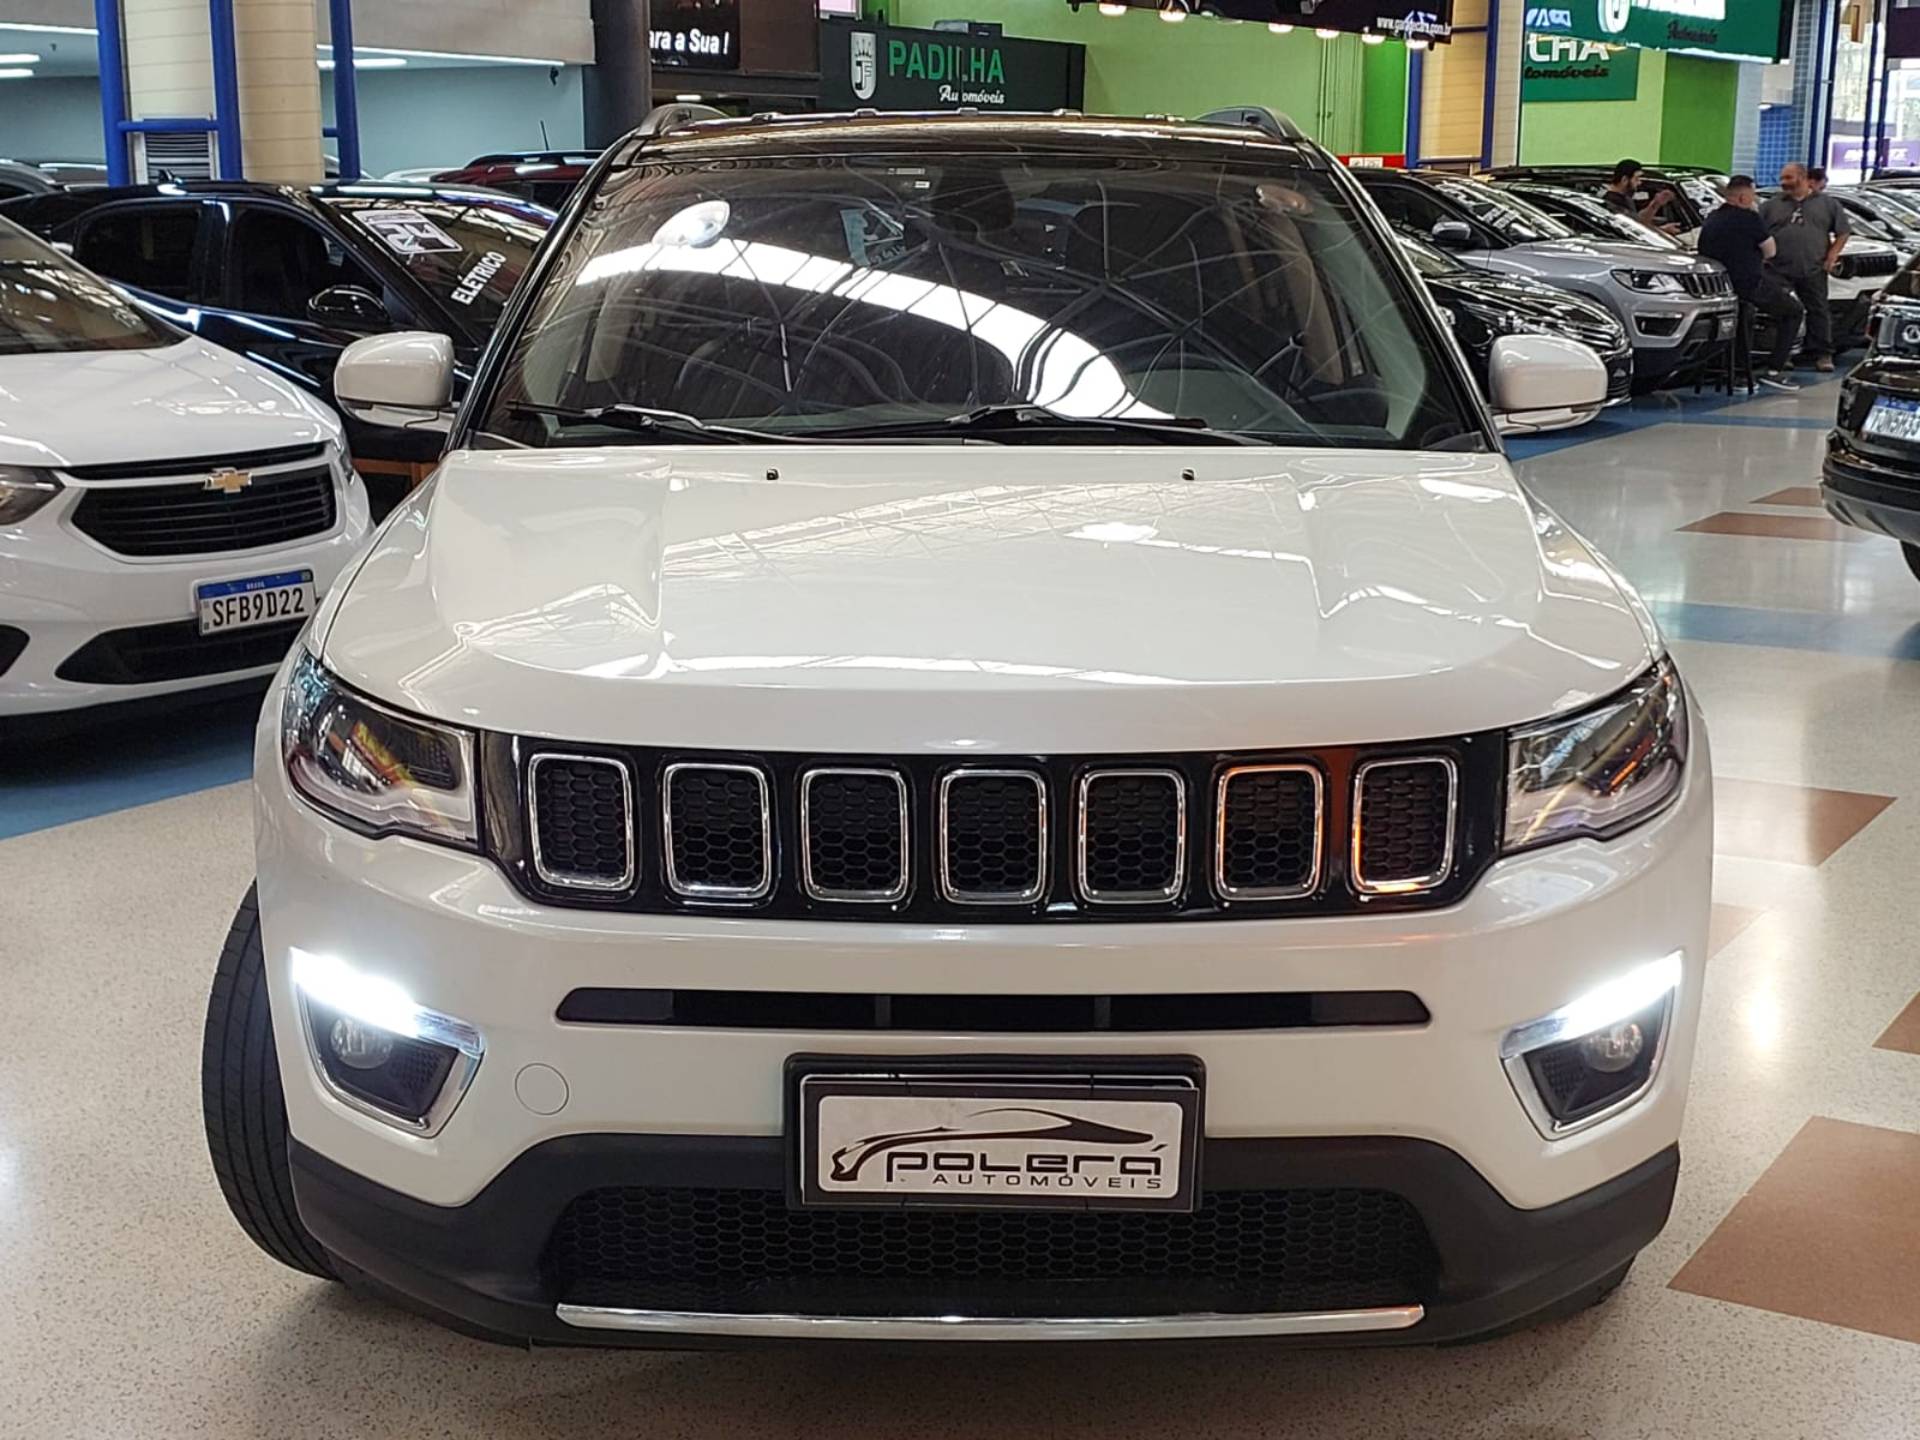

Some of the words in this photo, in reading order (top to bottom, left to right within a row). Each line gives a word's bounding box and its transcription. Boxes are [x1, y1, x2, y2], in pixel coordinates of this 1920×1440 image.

[674, 32, 686, 51] a
[689, 28, 720, 54] Sua
[723, 31, 730, 55] !
[888, 40, 1005, 84] PADILHA
[938, 84, 1005, 104] Auomóveis
[450, 251, 507, 306] ELÉTRICO
[213, 588, 304, 626] SFB9D22
[932, 1173, 1163, 1190] AUTOMÓVEIS
